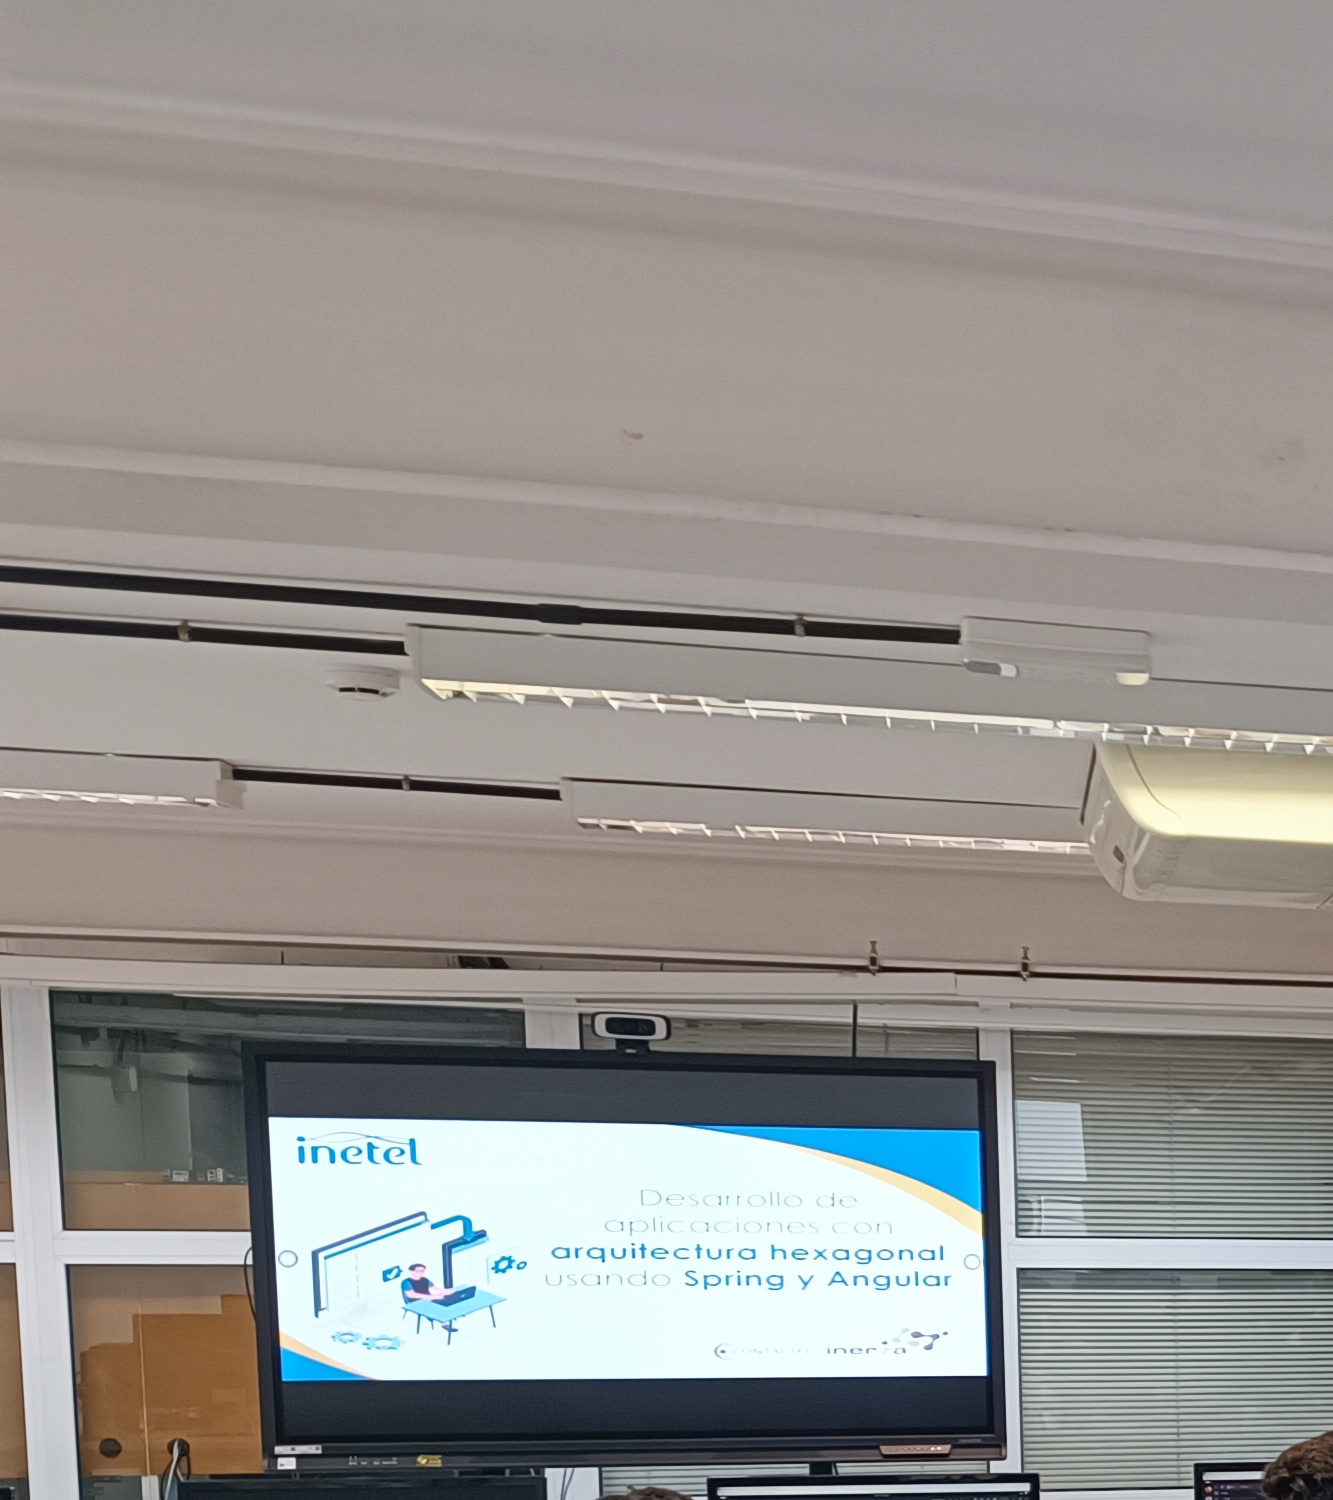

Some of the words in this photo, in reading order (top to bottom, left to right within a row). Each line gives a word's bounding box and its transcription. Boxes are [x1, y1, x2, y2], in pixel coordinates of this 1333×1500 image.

[296, 1135, 423, 1165] inetel
[640, 1189, 803, 1208] Desarrollo
[815, 1192, 858, 1208] de
[604, 1216, 819, 1236] aplicaciones
[831, 1220, 893, 1234] con
[551, 1243, 757, 1263] arquitectura
[771, 1245, 945, 1264] hexagonal
[545, 1271, 671, 1287] usando
[684, 1270, 785, 1291] Spring
[797, 1274, 814, 1291] y
[827, 1271, 952, 1291] Angular
